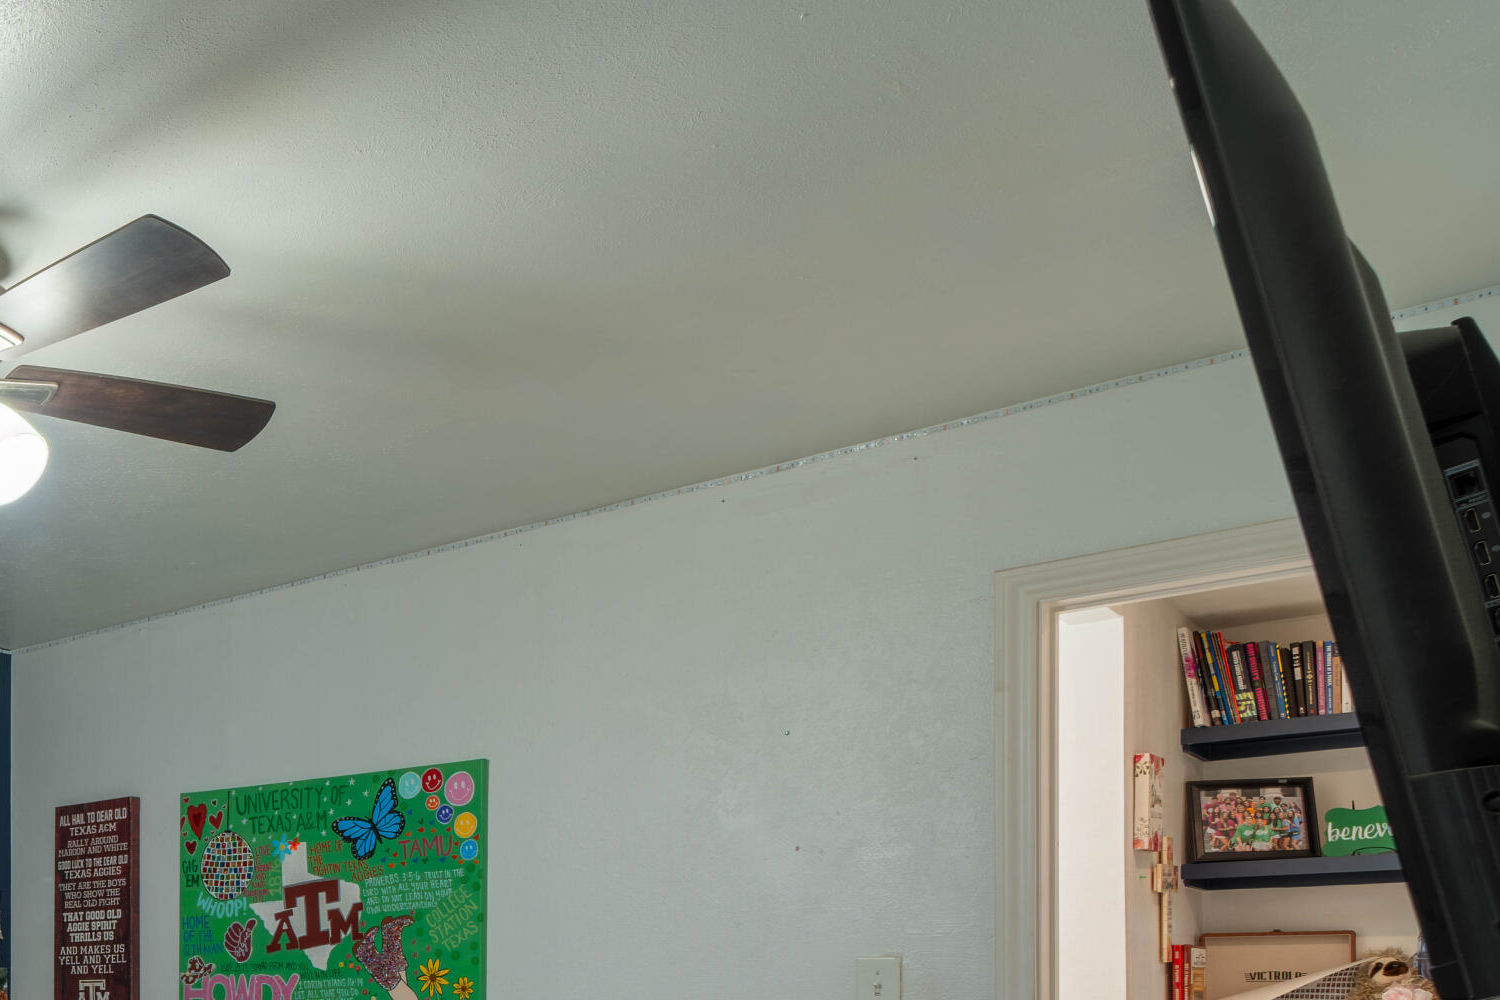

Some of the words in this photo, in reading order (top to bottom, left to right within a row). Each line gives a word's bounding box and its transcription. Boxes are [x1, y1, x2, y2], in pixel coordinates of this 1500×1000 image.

[236, 787, 324, 816] UNIVERSITY
[330, 785, 348, 806] OF
[60, 815, 71, 827] ALL
[71, 813, 85, 825] HAIL
[87, 811, 95, 823] TO
[96, 809, 113, 822] DEAR
[114, 807, 127, 820] OLD
[249, 812, 291, 834] TEXAS
[296, 811, 327, 831] A&M
[69, 825, 97, 837] TEXAS
[67, 838, 90, 848] RALLY
[91, 835, 118, 846] AROUND
[310, 840, 333, 855] HOME
[398, 835, 453, 860] TAMU
[58, 848, 86, 858] MAROON
[87, 845, 102, 854] AND
[104, 842, 129, 853] WHITE
[58, 860, 72, 871] GOOD
[71, 859, 84, 869] LUCK
[93, 857, 102, 867] THE
[103, 855, 117, 866] DEAR
[118, 854, 128, 865] OLD
[182, 860, 198, 874] GIG
[308, 855, 323, 866] THE
[342, 860, 368, 872] TEXAS
[64, 869, 91, 880] TEXAS
[93, 866, 122, 877] AGGIES
[352, 865, 384, 882] AGGIES
[365, 873, 399, 888] PROVERBS
[424, 871, 443, 880] TRUST
[452, 868, 464, 877] THE
[58, 882, 77, 892] THEY
[77, 881, 91, 890] ARE
[92, 880, 106, 889] THE
[107, 878, 127, 887] BOYS
[398, 883, 410, 891] ALL
[430, 879, 452, 888] HEART
[64, 891, 81, 900] WHO
[83, 889, 105, 899] SHOW
[105, 888, 120, 897] THE
[64, 900, 82, 909] REAL
[83, 899, 97, 908] OLD
[98, 897, 120, 907] FIGHT
[196, 891, 247, 919] WHOOP!
[425, 883, 473, 929] COLLEGE
[62, 911, 84, 922] THAT
[85, 910, 105, 921] GOOD
[106, 908, 122, 919] OLD
[182, 915, 210, 929] HOME
[428, 899, 479, 944] STATION
[66, 922, 90, 933] AGGIE
[91, 920, 118, 931] SPIRIT
[69, 931, 102, 943] THRILLS
[103, 931, 114, 941] US
[441, 920, 479, 952] TEXAS
[60, 946, 78, 956] AND
[80, 944, 111, 955] MAKES
[113, 943, 125, 953] US
[58, 955, 80, 966] YELL
[83, 954, 101, 965] AND
[104, 954, 127, 964] YELL
[70, 965, 89, 975] AND
[91, 964, 114, 974] YELL
